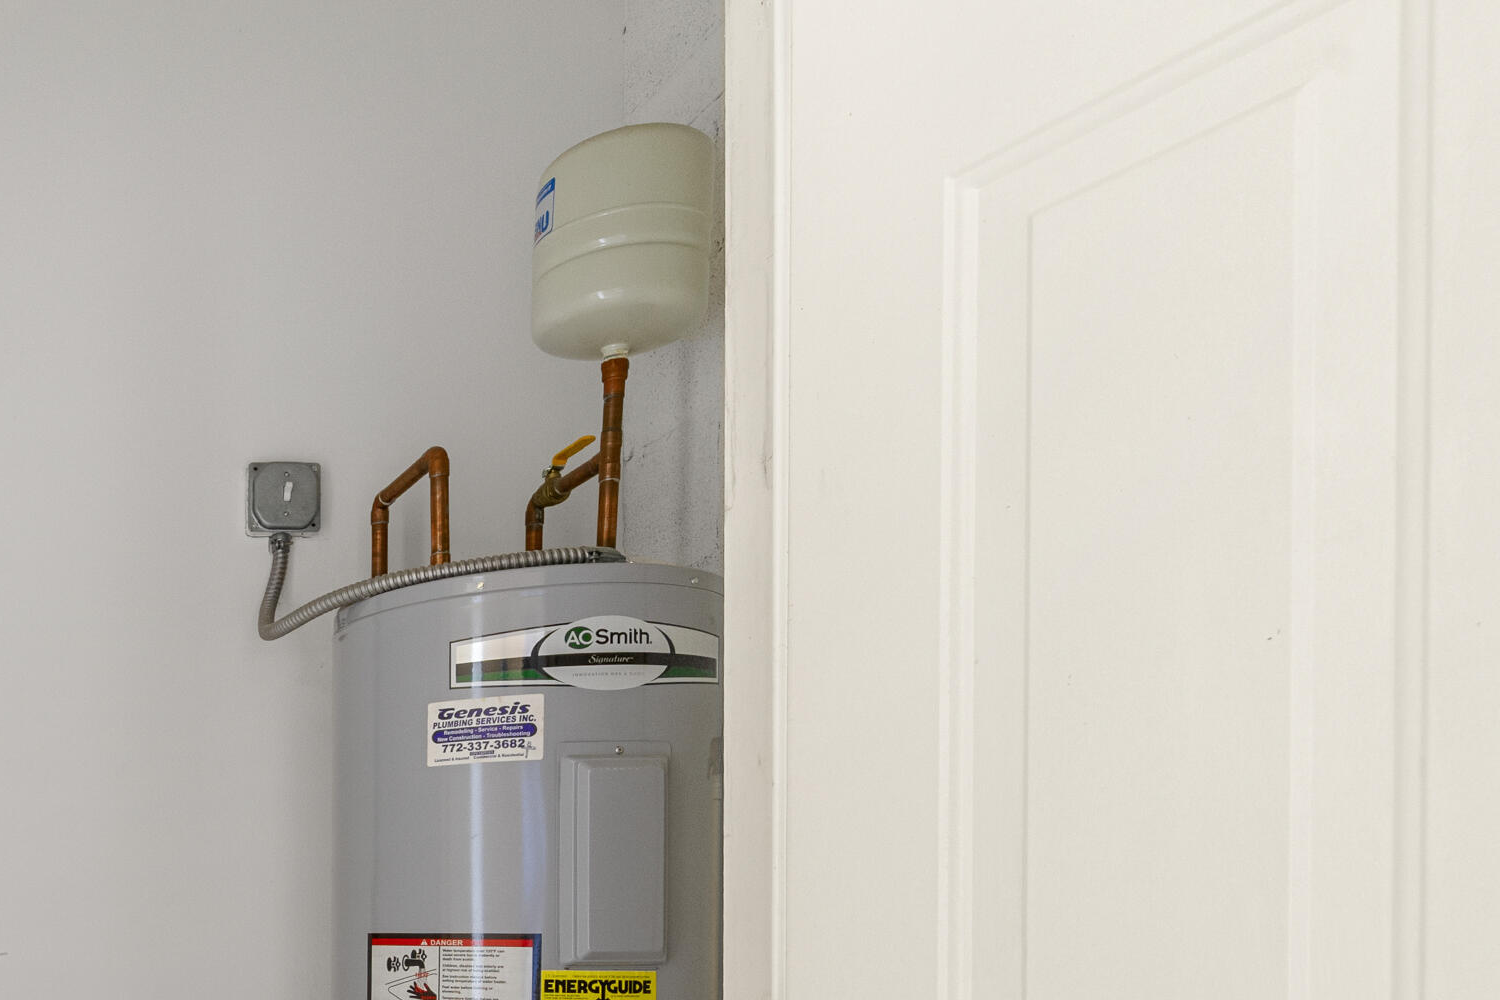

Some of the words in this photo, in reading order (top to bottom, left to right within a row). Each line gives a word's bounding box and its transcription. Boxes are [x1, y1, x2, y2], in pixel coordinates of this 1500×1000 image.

[588, 654, 630, 664] Signature
[438, 702, 531, 720] Genesis
[433, 719, 473, 729] PLUMBING
[476, 715, 516, 725] SERVICES
[444, 728, 473, 736] Remodeling
[442, 739, 525, 753] 772-337-3682
[544, 979, 651, 994] ENERGYGUIDE
